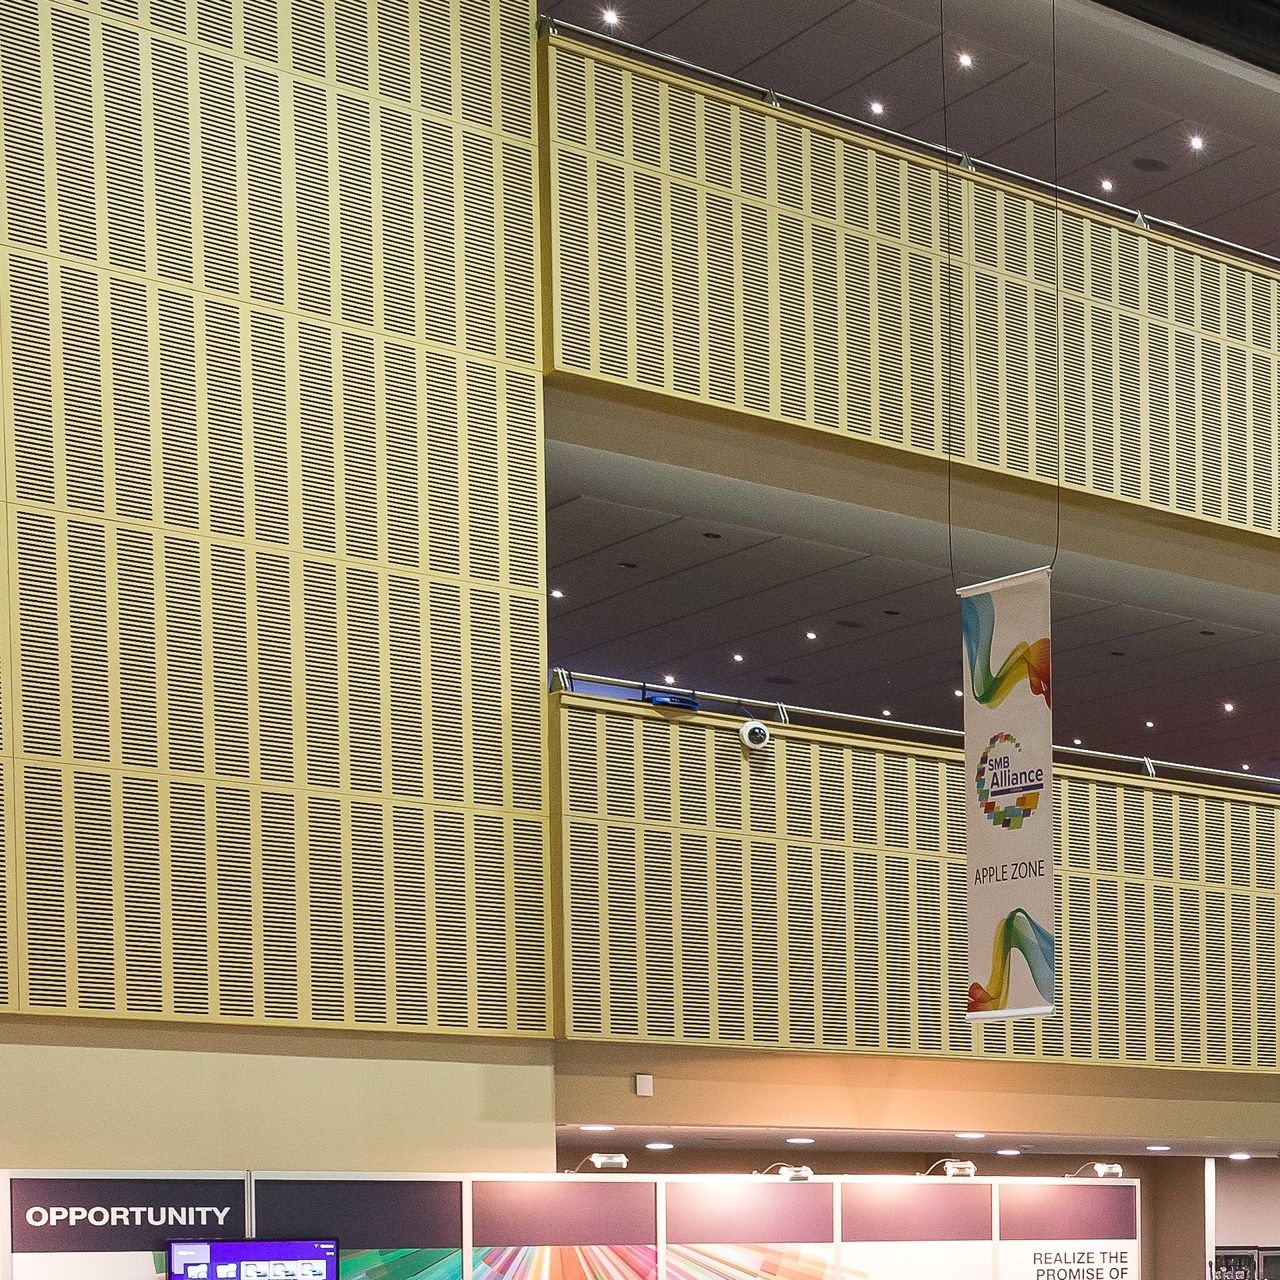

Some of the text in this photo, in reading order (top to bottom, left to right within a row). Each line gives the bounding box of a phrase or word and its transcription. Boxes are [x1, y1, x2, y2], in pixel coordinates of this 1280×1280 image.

[988, 756, 1010, 772] SMB
[990, 768, 1044, 790] Alliance
[974, 859, 1045, 886] APPLE ZONE
[25, 1206, 230, 1227] OPPORTUNITY
[1033, 1251, 1128, 1265] REALIZE THE
[1036, 1267, 1129, 1280] PROMISE OF
